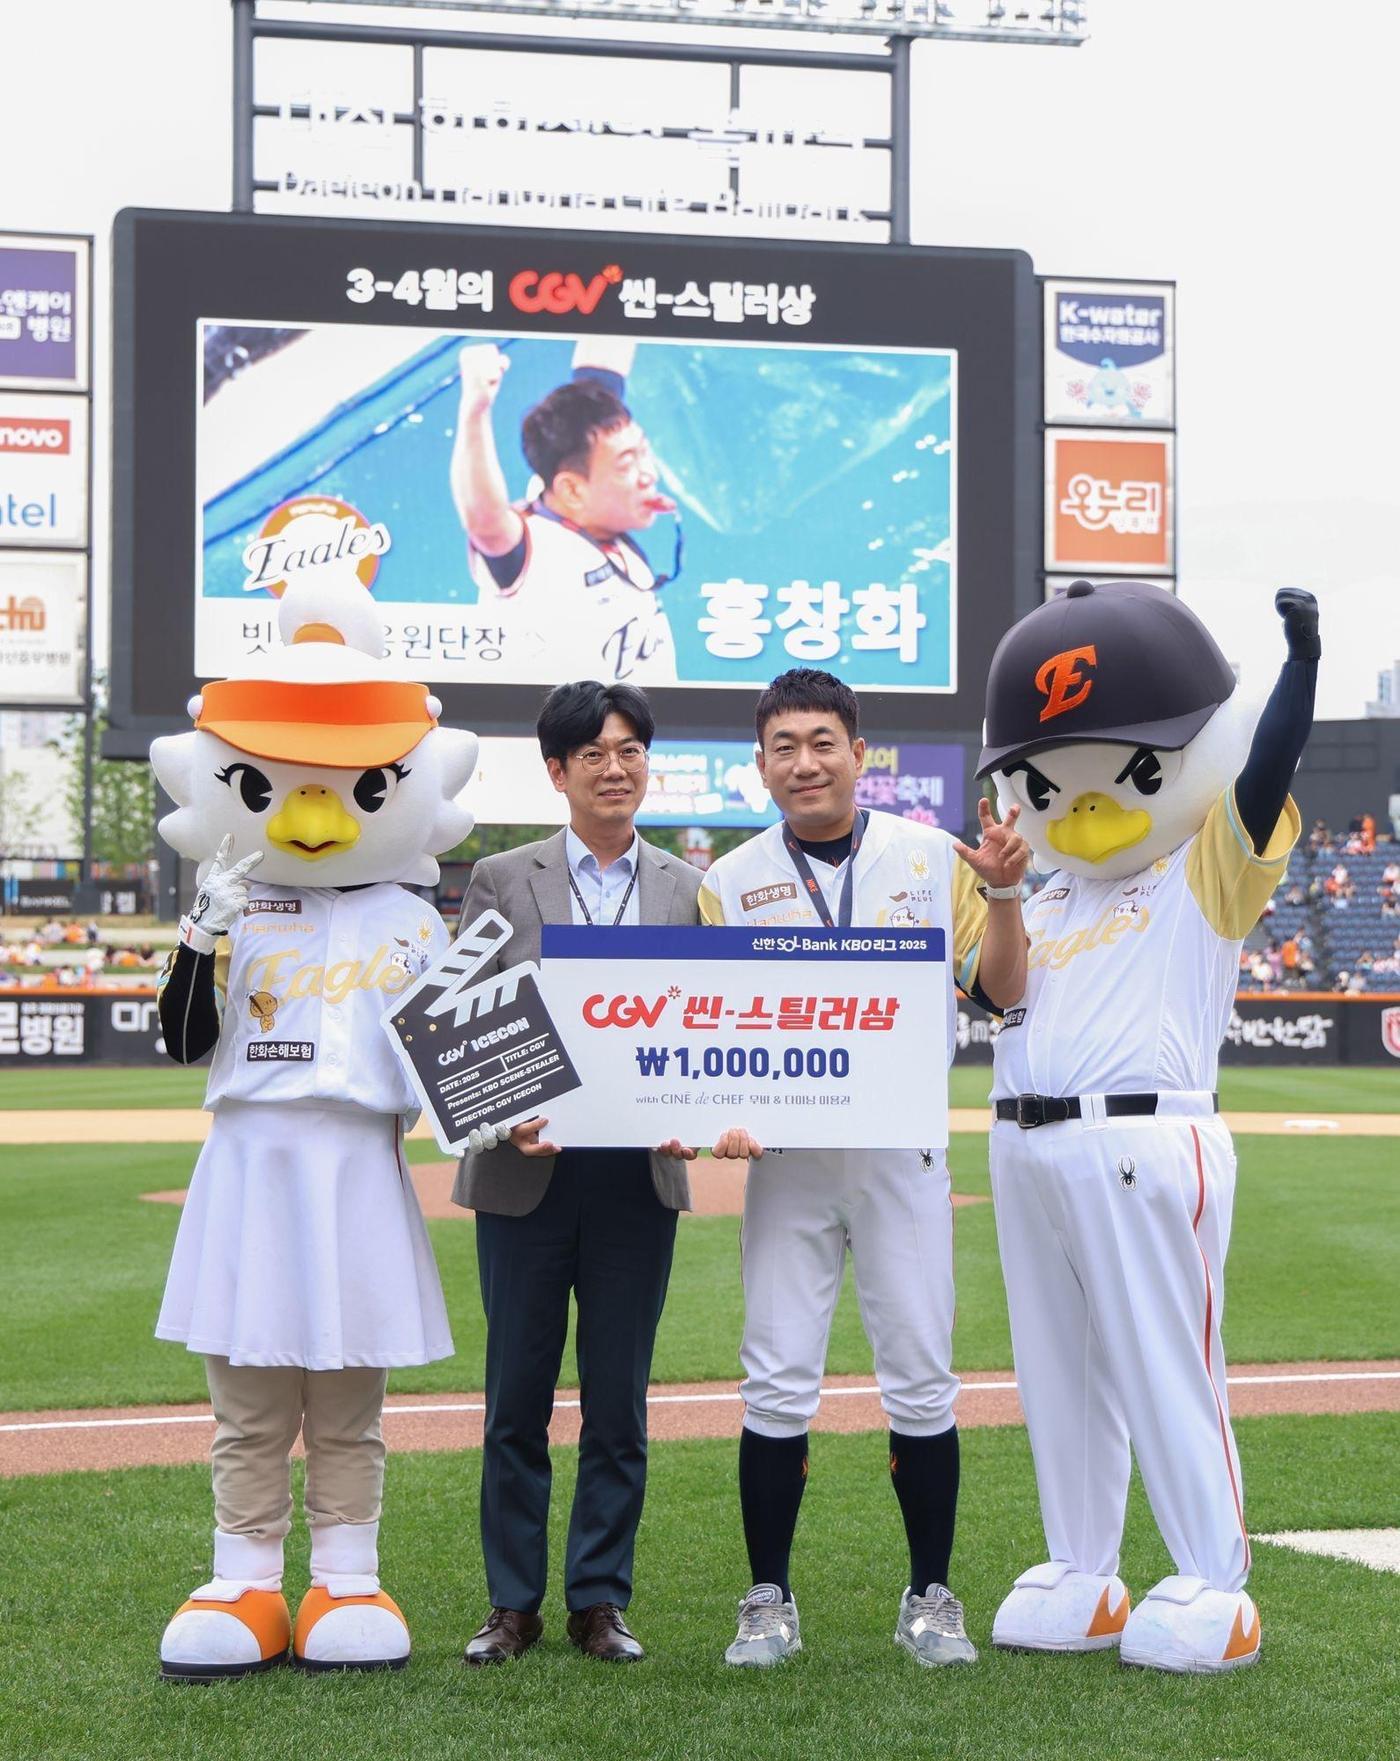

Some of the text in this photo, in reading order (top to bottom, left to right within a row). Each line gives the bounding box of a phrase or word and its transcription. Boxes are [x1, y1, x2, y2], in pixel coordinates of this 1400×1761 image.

[346, 267, 817, 326] 3-4월의 CGV 씬-스틸러상
[1060, 300, 1162, 327] K-water
[0, 493, 56, 527] tel
[697, 578, 927, 663] 홍창화
[1034, 645, 1098, 723] E
[248, 900, 297, 912] 한화생명
[745, 884, 792, 908] 한화생명
[751, 937, 776, 951] 신한
[802, 937, 838, 951] Bank
[840, 939, 872, 951] KBO
[873, 938, 897, 952] 리그
[899, 939, 928, 950] 2025
[582, 993, 900, 1031] CGV 씬-스틸러상
[249, 1043, 312, 1059] 한화손해보험
[438, 1017, 530, 1066] CGV ICECON
[505, 1040, 546, 1063] TITLE: CGV
[635, 1046, 850, 1080] ₩1,000,000
[447, 1054, 560, 1110] Presents: KBO SCENE-STEALER
[635, 1095, 659, 1104] with
[694, 1091, 710, 1105] de
[712, 1094, 745, 1105] CHEF
[773, 1094, 782, 1105] &
[454, 1083, 542, 1128] DIRECTOR: CGV ICECON
